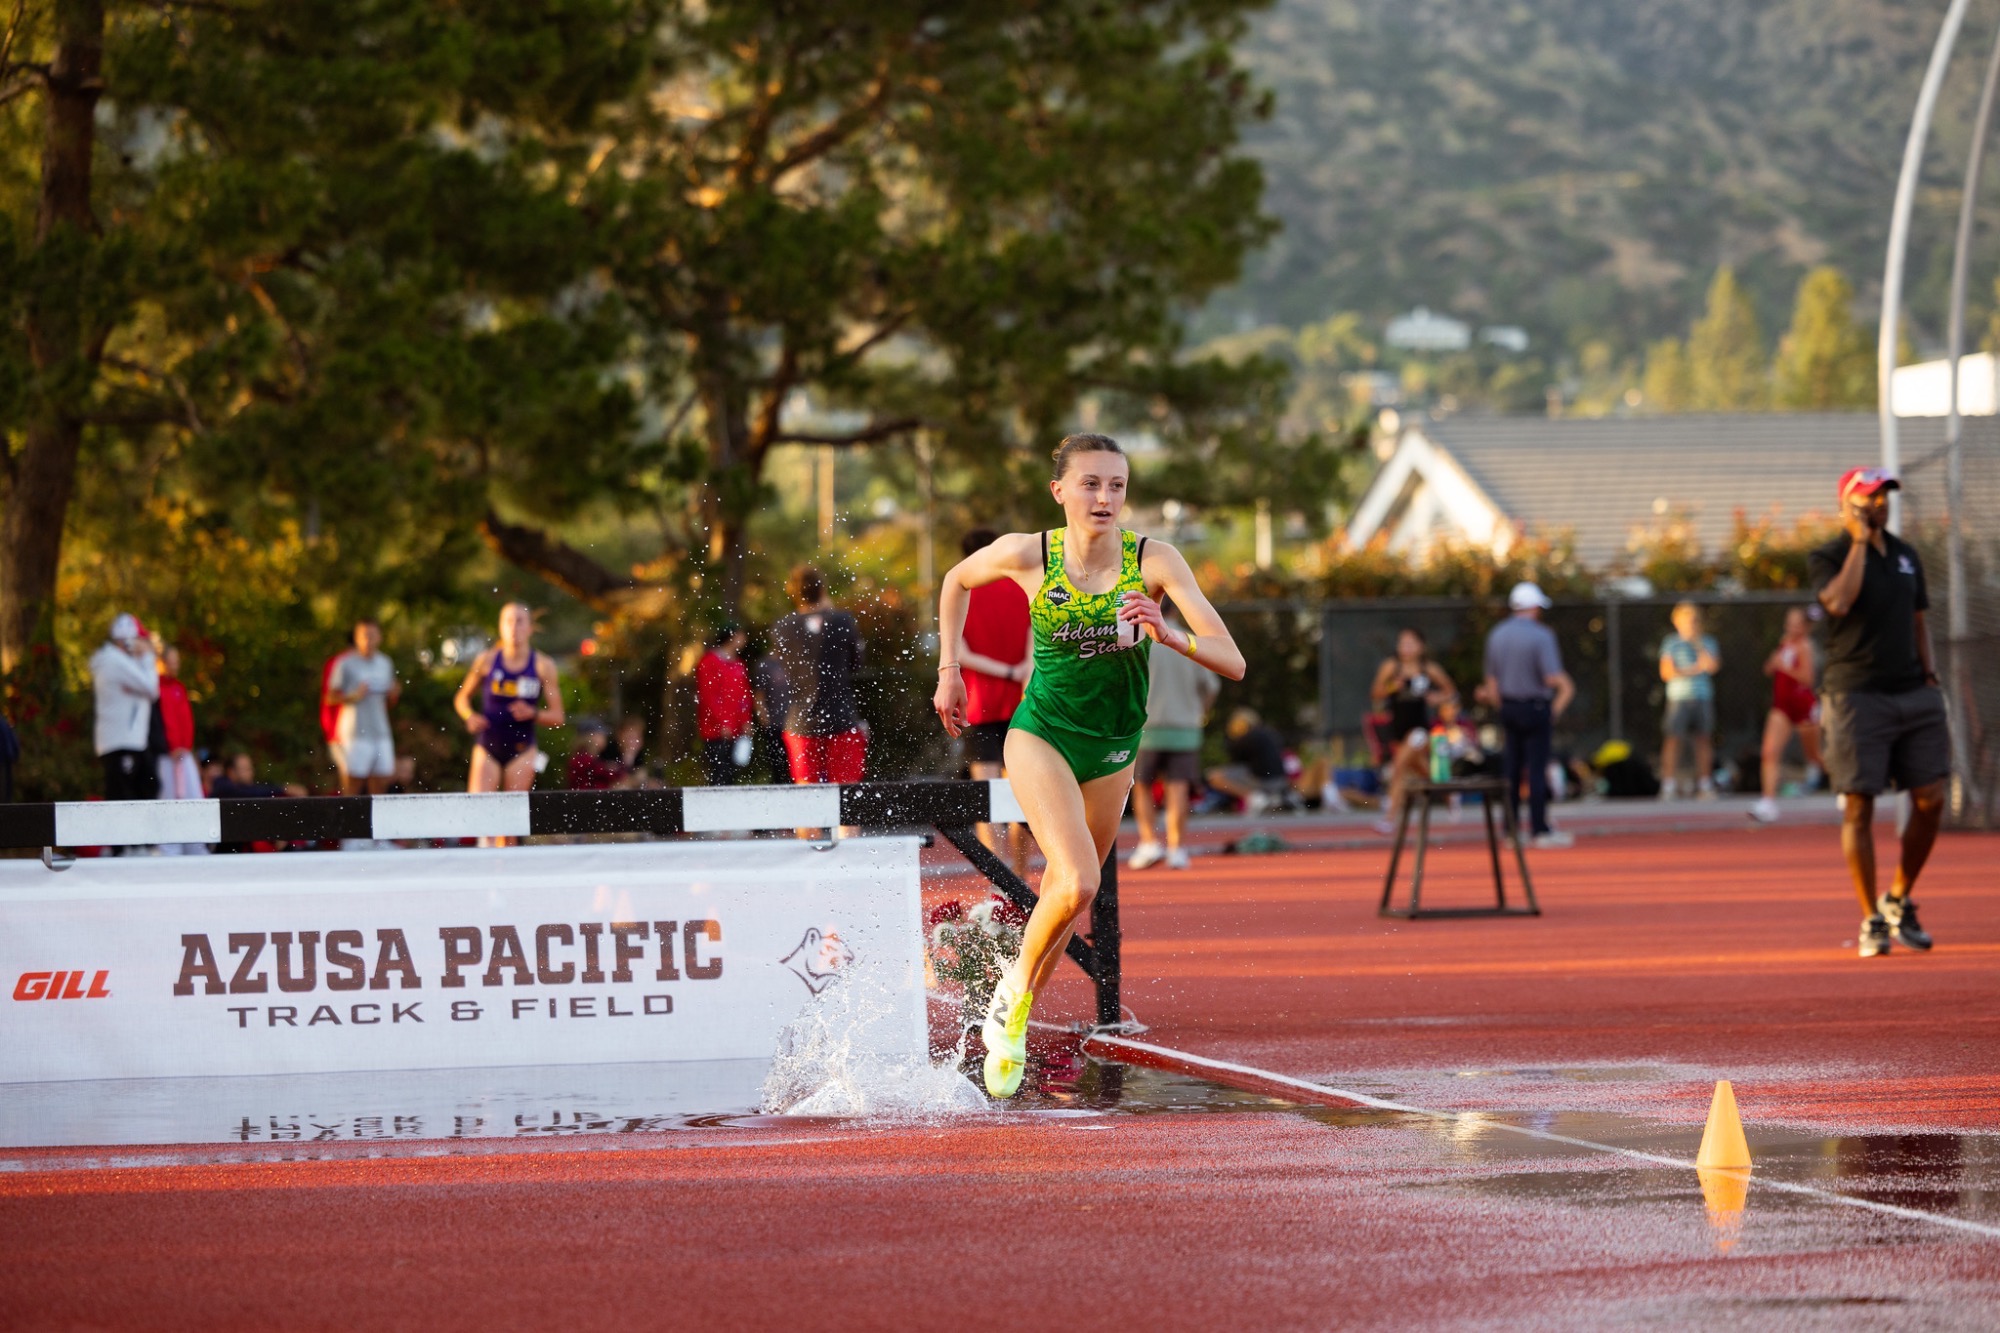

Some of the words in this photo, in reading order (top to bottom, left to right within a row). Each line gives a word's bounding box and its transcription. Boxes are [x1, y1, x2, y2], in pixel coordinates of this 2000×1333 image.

[1048, 591, 1070, 601] RMAC
[1078, 640, 1134, 659] Sta
[174, 928, 422, 997] AZUSA
[438, 919, 723, 988] PACIFIC
[13, 970, 111, 1001] GILL
[227, 1002, 424, 1028] TRACK
[450, 1000, 484, 1021] &
[512, 994, 674, 1020] FIELD
